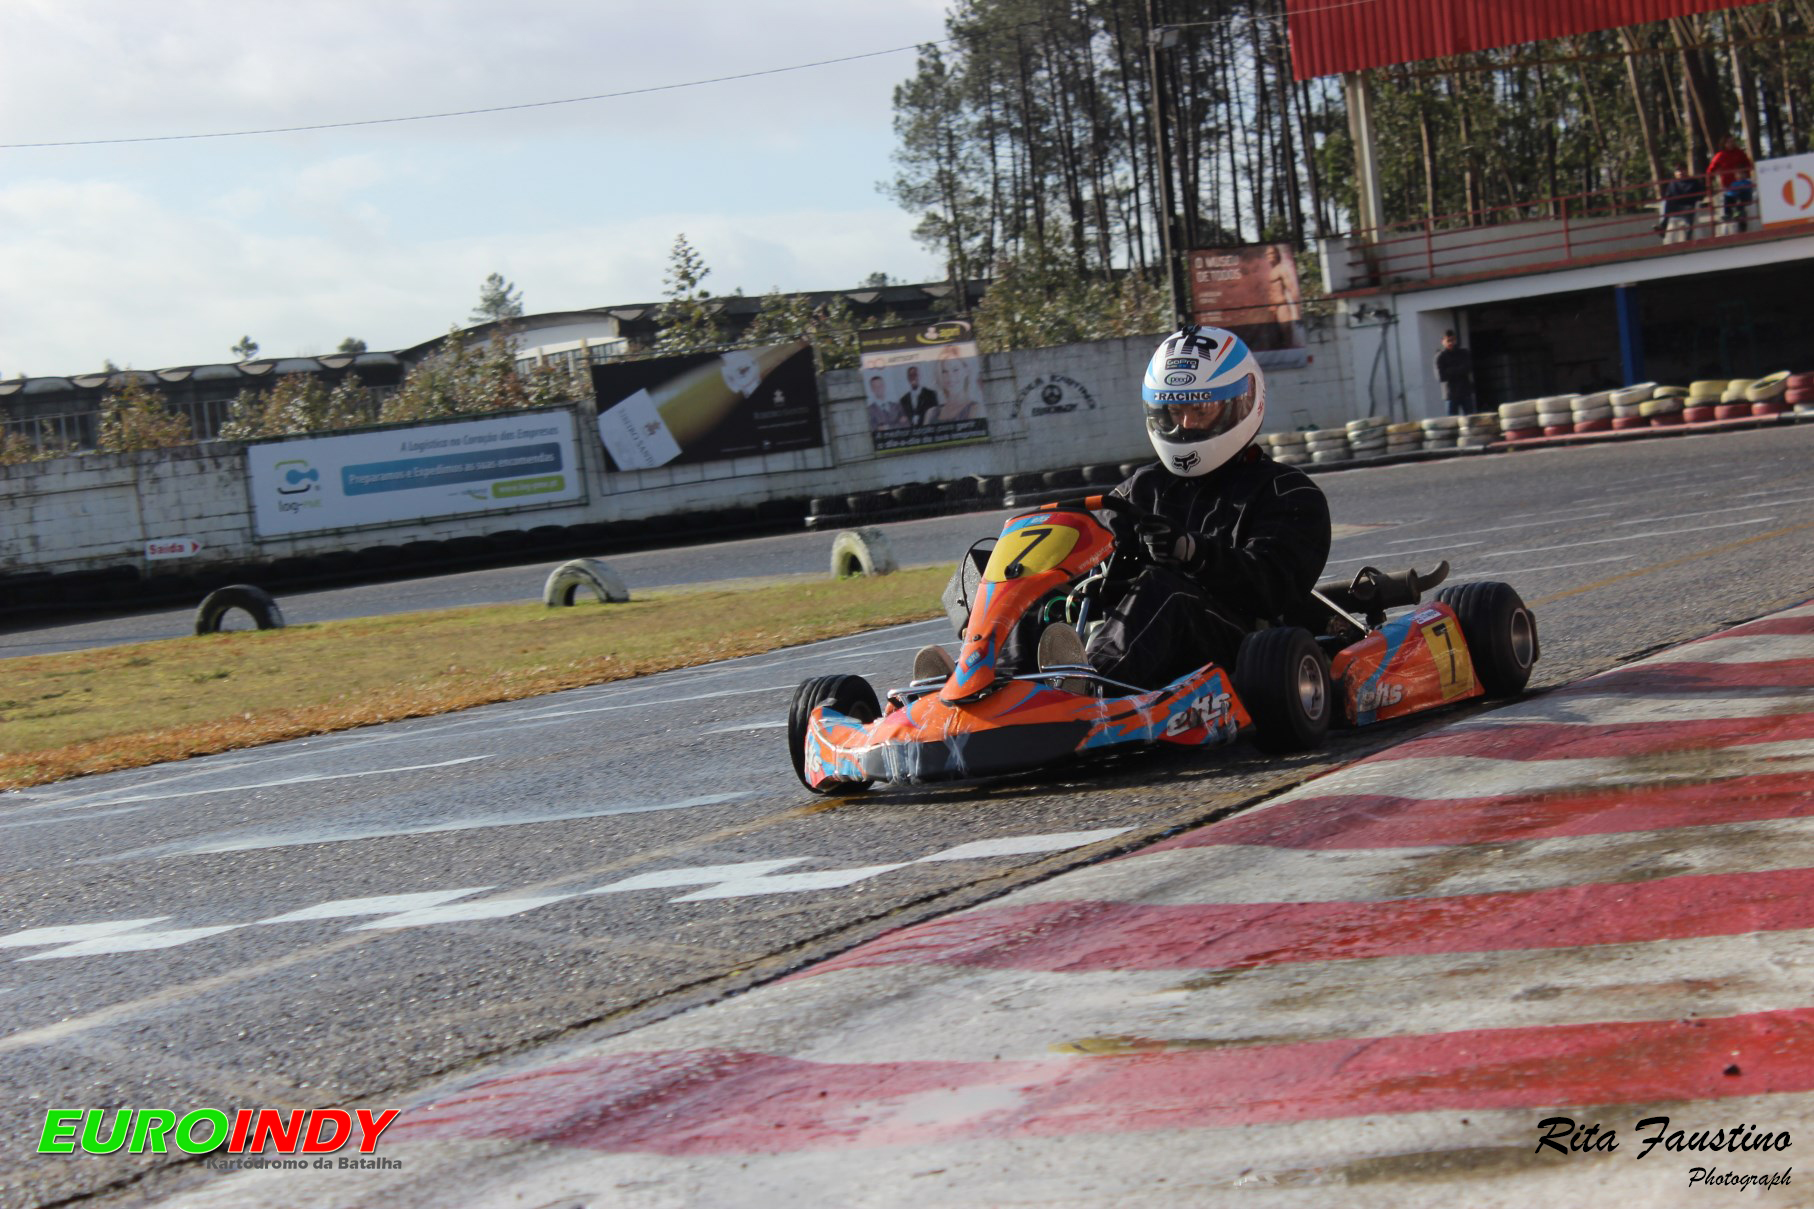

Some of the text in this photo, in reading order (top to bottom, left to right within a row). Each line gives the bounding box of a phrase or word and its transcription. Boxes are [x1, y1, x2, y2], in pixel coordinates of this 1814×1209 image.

[1157, 391, 1211, 401] RACING
[1009, 528, 1053, 571] 7
[1432, 623, 1456, 685] 7
